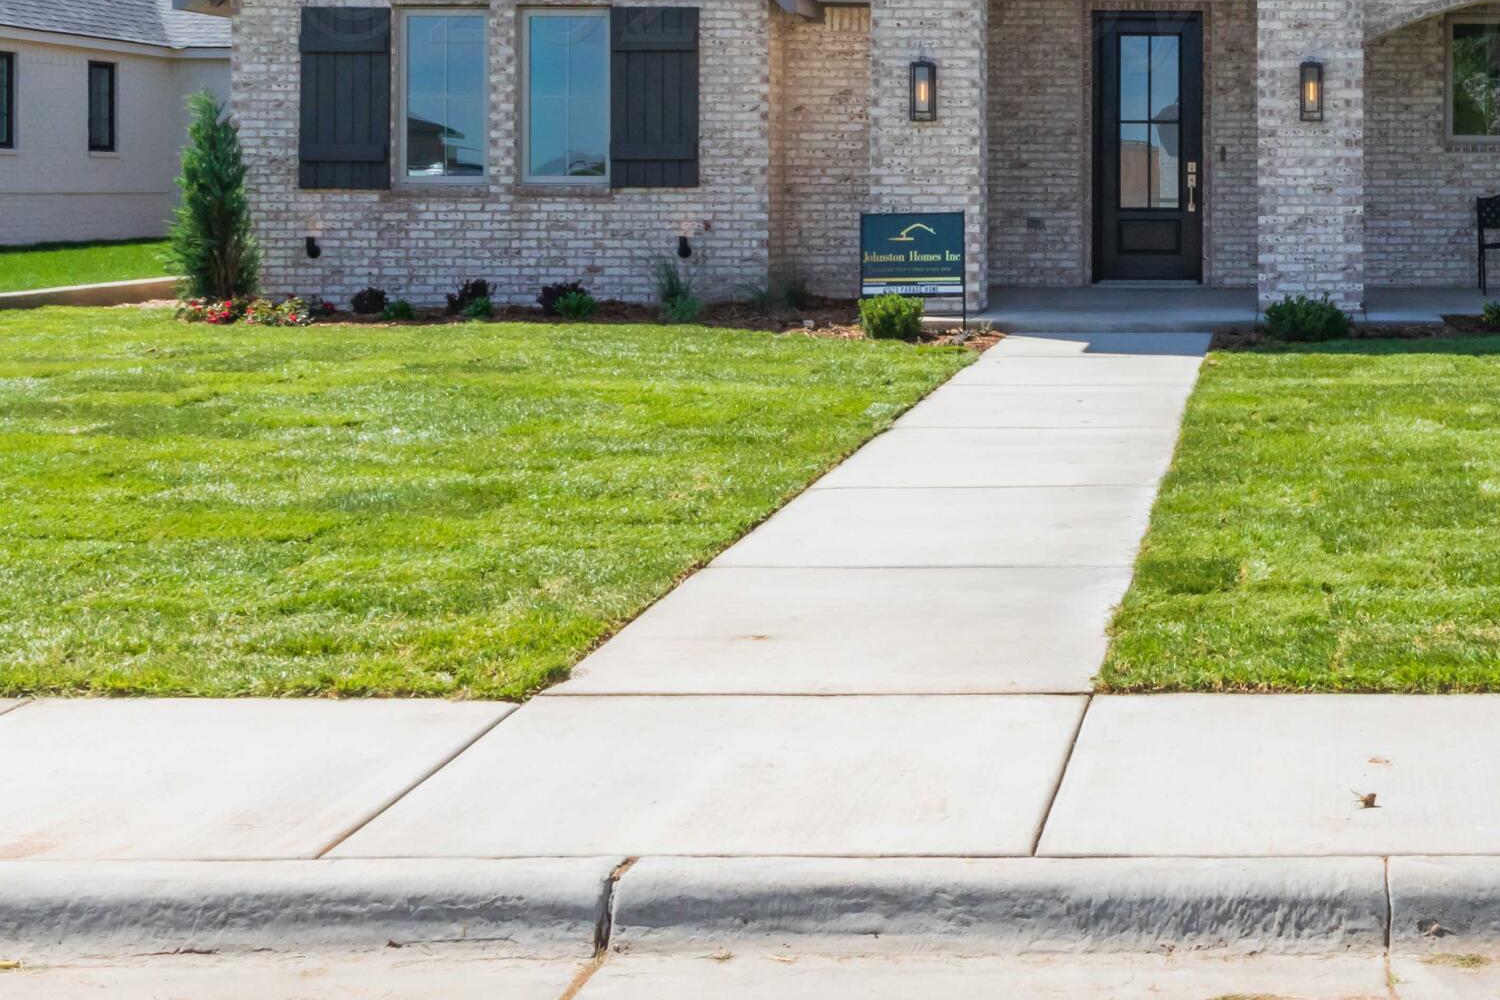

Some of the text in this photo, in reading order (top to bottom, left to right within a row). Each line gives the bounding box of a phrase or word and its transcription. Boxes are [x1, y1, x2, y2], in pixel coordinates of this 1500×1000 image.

[863, 250, 961, 263] Johnston Homes Inc
